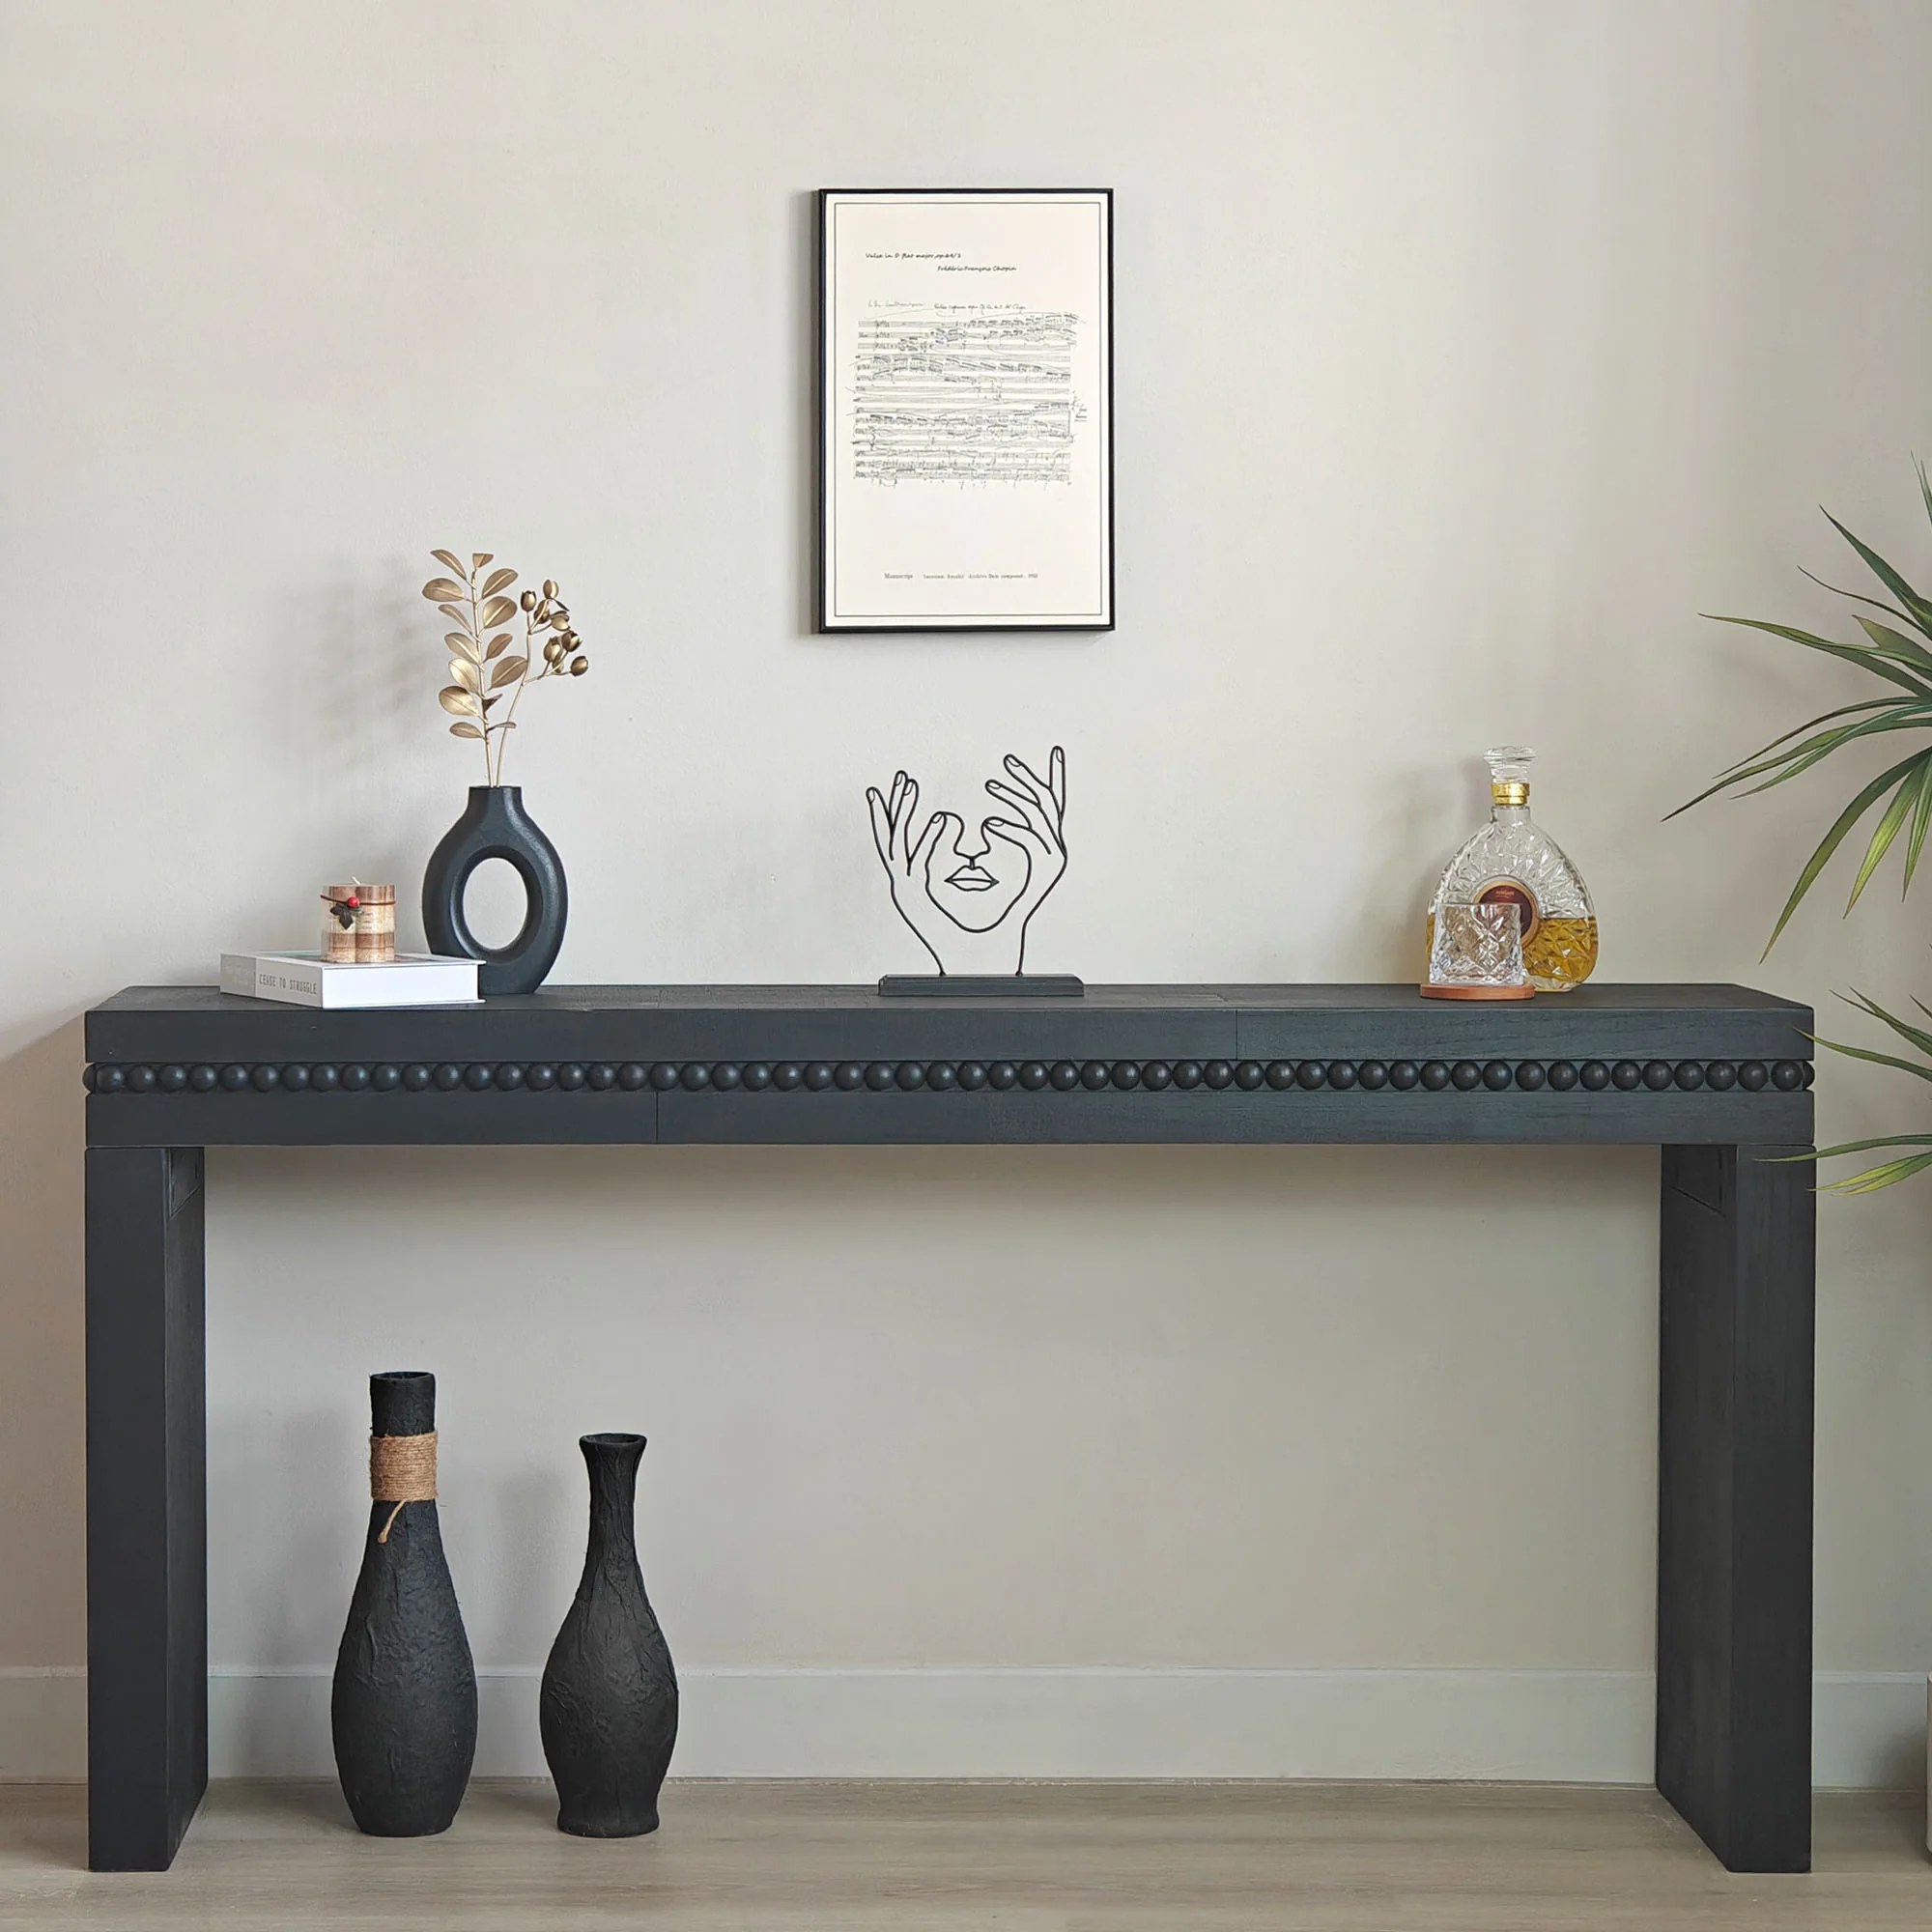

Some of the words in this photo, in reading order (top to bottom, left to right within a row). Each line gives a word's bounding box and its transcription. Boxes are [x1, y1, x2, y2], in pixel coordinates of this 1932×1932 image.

[259, 973, 276, 987] CEASE
[279, 977, 286, 989] TO
[289, 979, 318, 995] STRUGGLE
